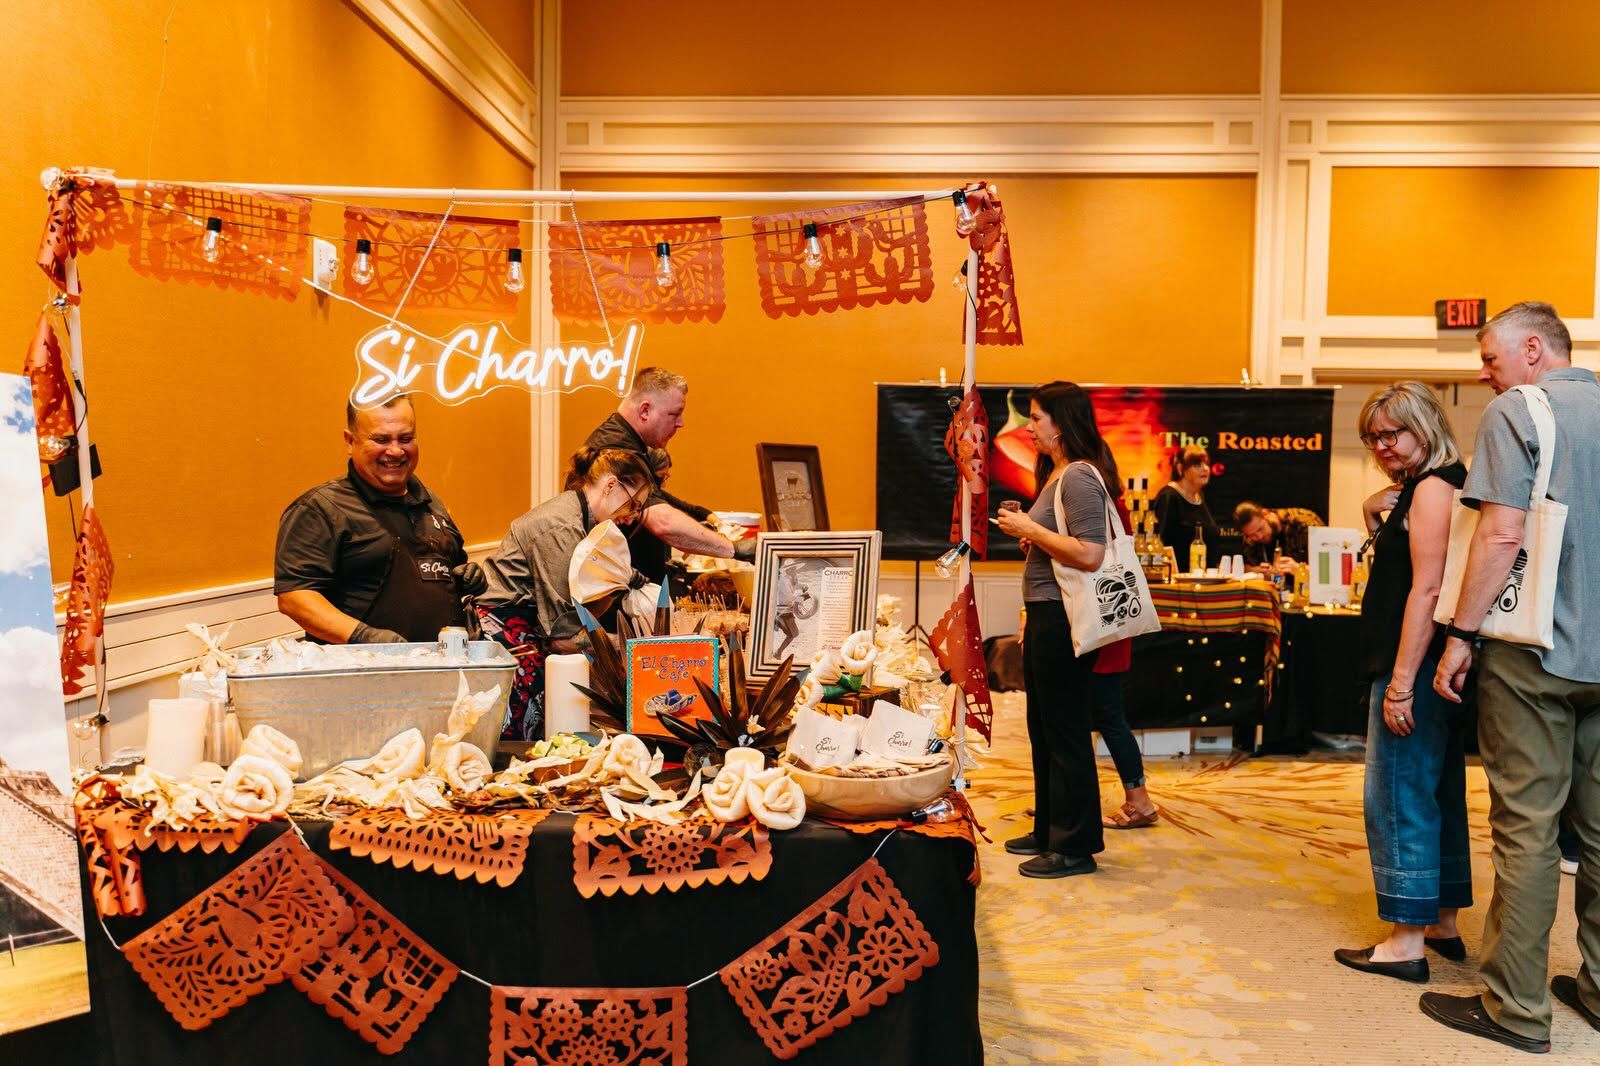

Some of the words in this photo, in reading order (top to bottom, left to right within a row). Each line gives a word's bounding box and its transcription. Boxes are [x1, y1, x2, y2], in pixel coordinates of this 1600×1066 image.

[1446, 299, 1480, 326] EXIT
[355, 328, 422, 404] Si
[436, 325, 638, 399] Charro!
[1160, 432, 1210, 449] The
[1218, 432, 1323, 450] Roasted
[420, 562, 431, 573] Si
[641, 655, 658, 670] El
[659, 656, 707, 671] Charro
